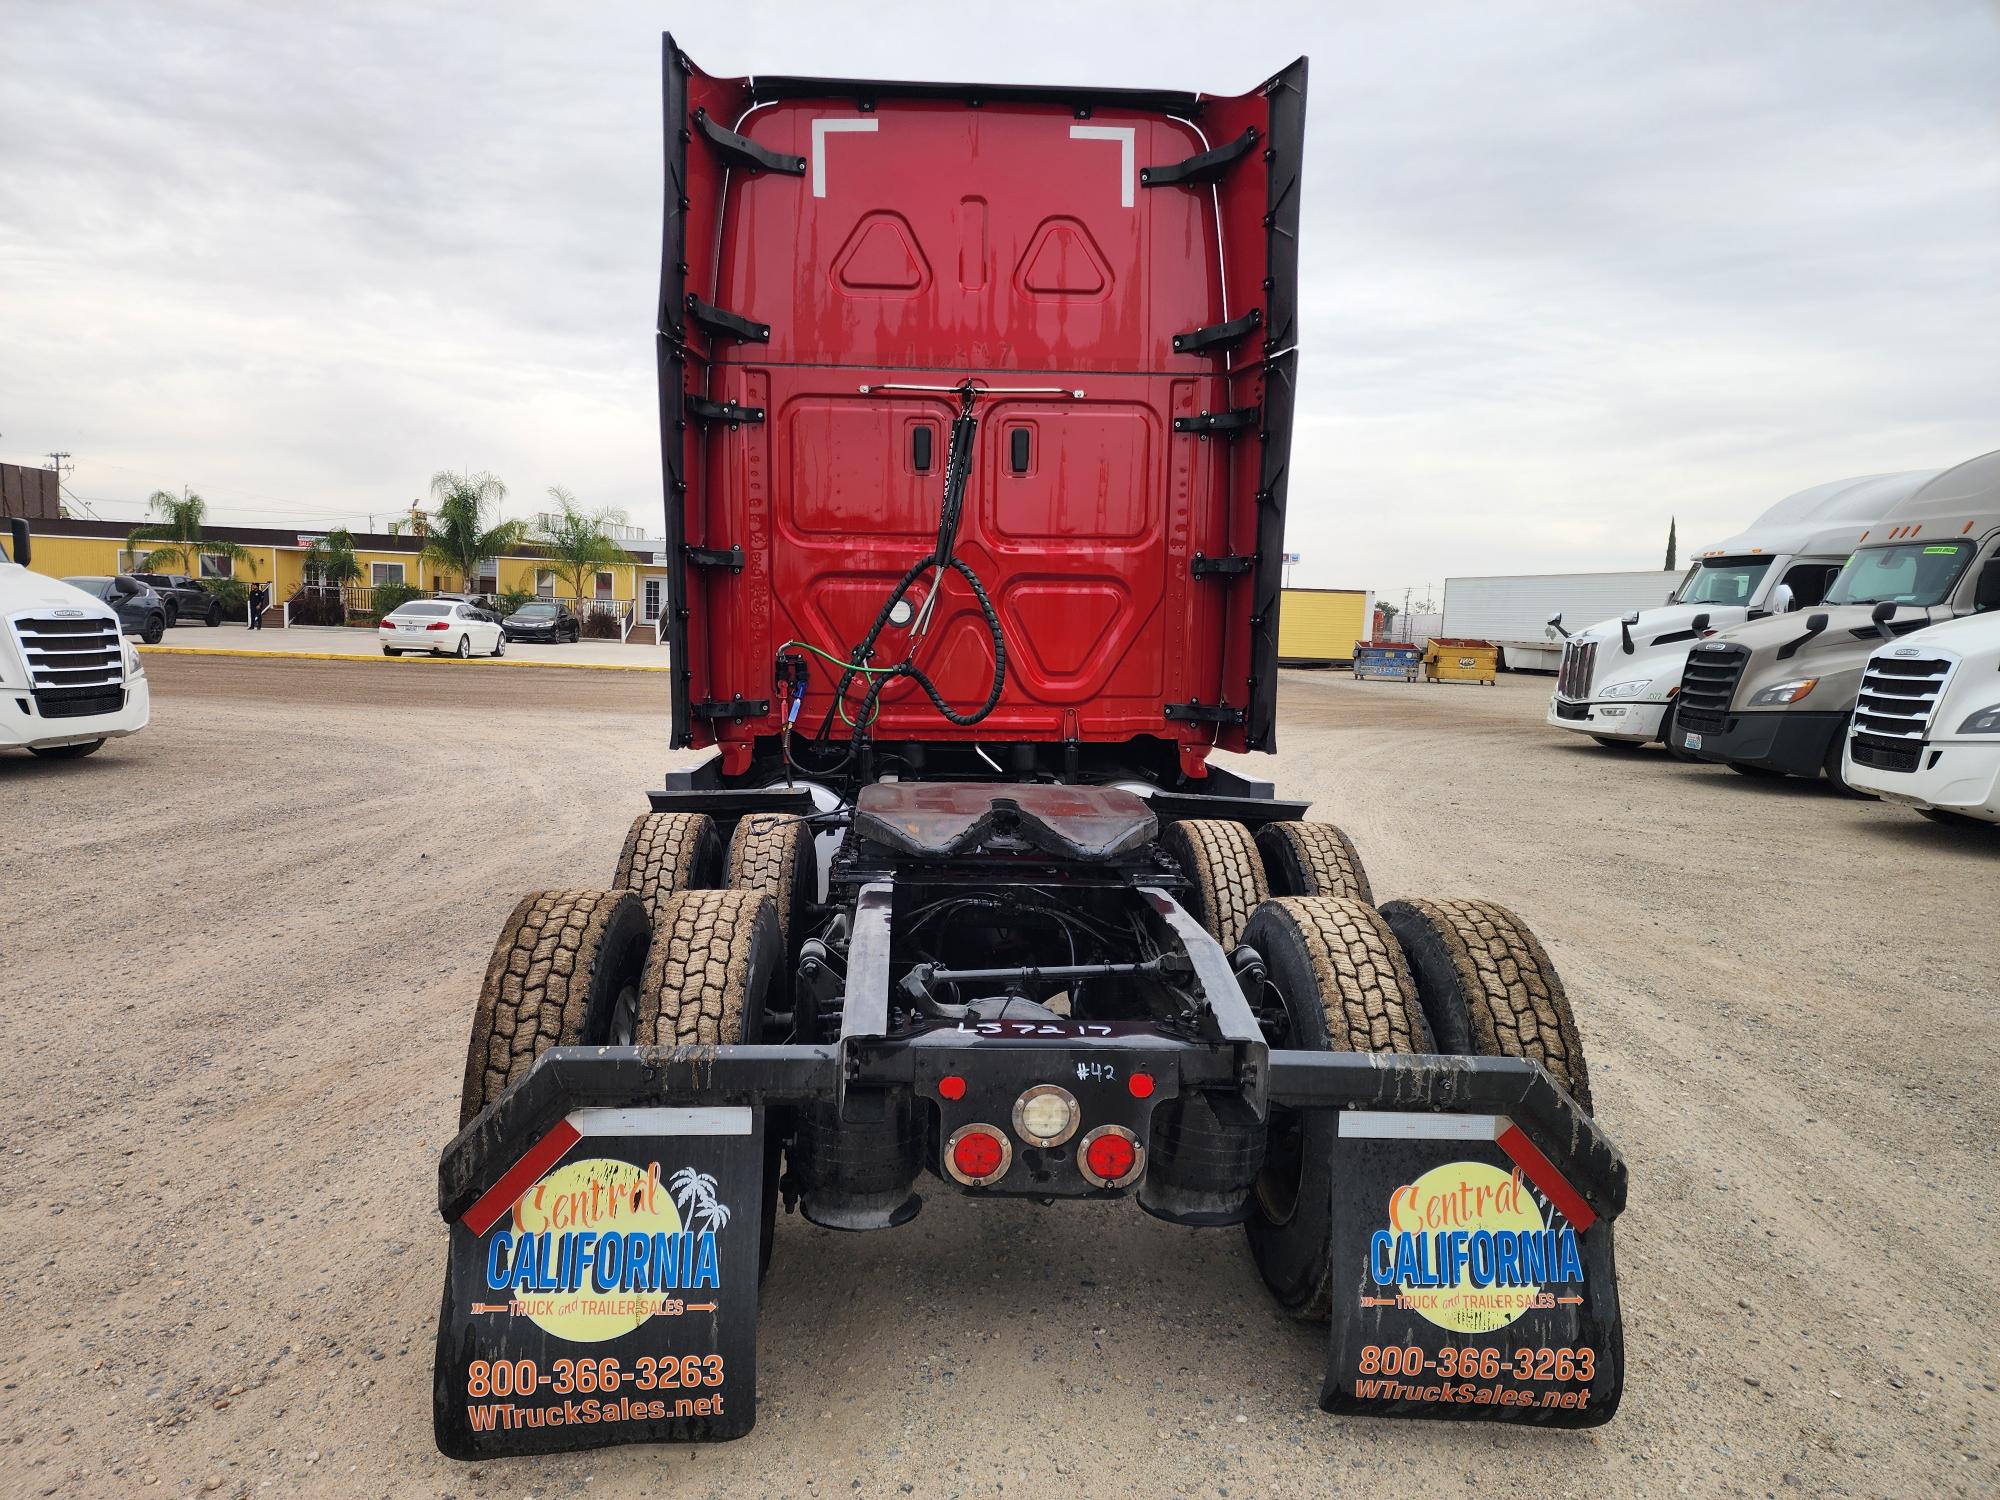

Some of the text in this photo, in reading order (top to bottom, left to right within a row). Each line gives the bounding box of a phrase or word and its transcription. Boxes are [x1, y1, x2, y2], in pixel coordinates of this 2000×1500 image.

[1075, 1062, 1118, 1083] #42
[512, 1161, 662, 1237] Central
[1388, 1165, 1525, 1236] Central
[486, 1230, 721, 1293] CALIFORNIA
[1370, 1229, 1585, 1289] CALIFORNIA
[509, 1297, 685, 1317] TRUCK and TRAILER SALES
[1396, 1292, 1556, 1310] TRUCK and TRAILER SALES
[467, 1355, 725, 1398] 800-366-3263
[1358, 1346, 1596, 1381] 800-366-3263
[467, 1393, 725, 1432] WTruckSales.net
[1355, 1379, 1592, 1410] WTruckSales.net
